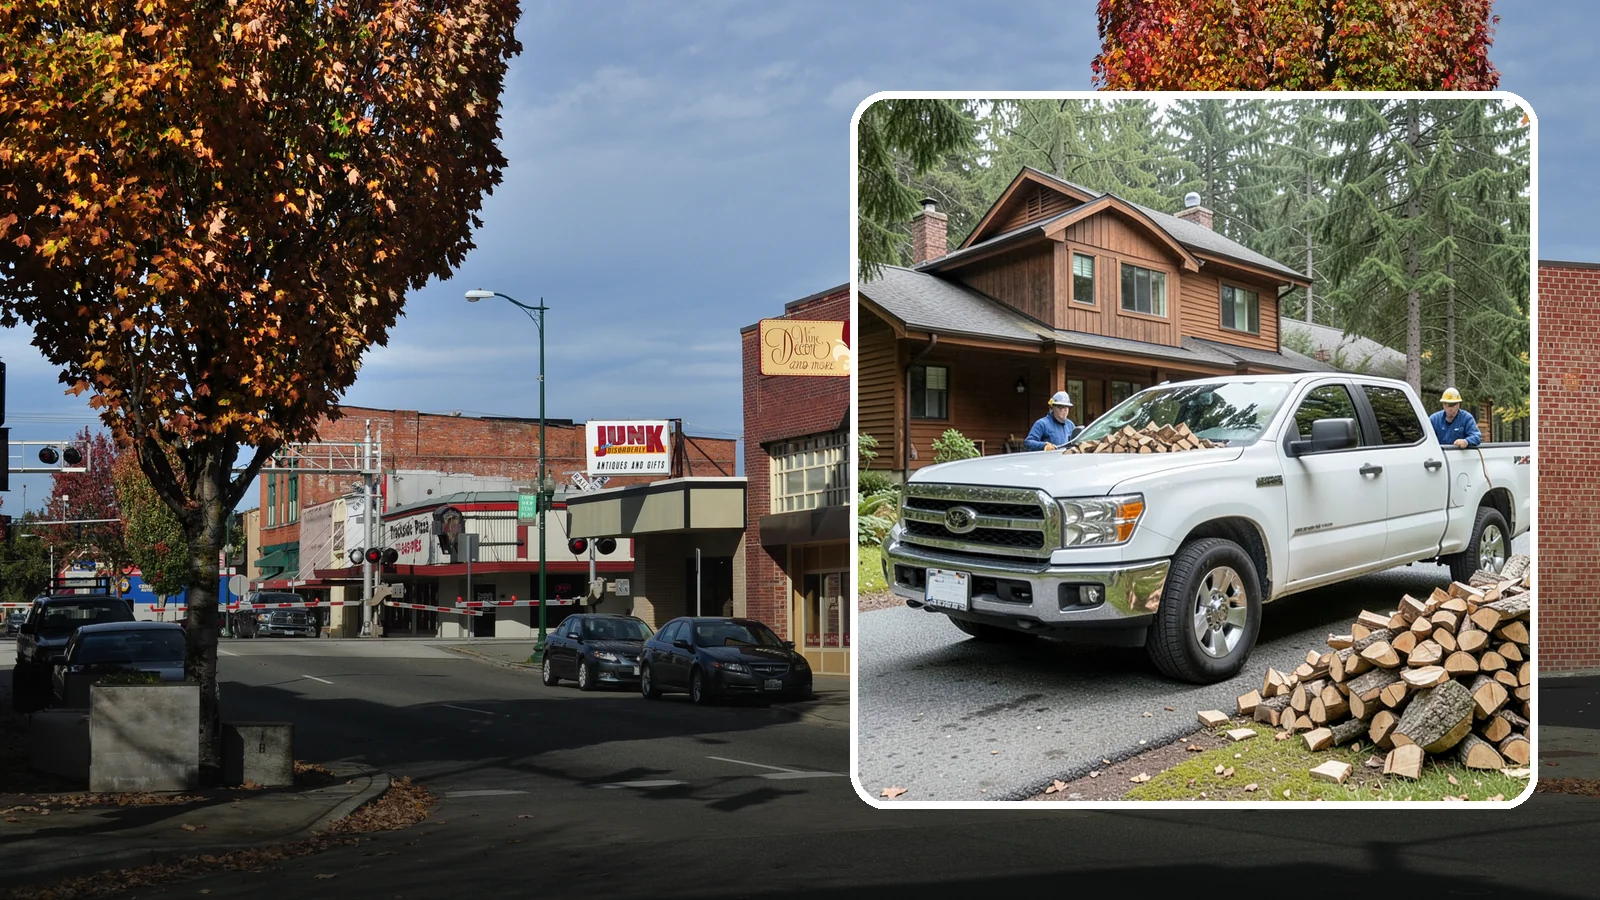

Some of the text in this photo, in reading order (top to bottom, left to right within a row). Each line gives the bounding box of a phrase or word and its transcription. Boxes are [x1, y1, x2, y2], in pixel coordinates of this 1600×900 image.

[595, 425, 666, 457] JUNK
[607, 446, 646, 454] DISORDERLY
[597, 461, 665, 470] ANTIQUES AND GIFTS
[390, 519, 429, 539] Trackside Pizza
